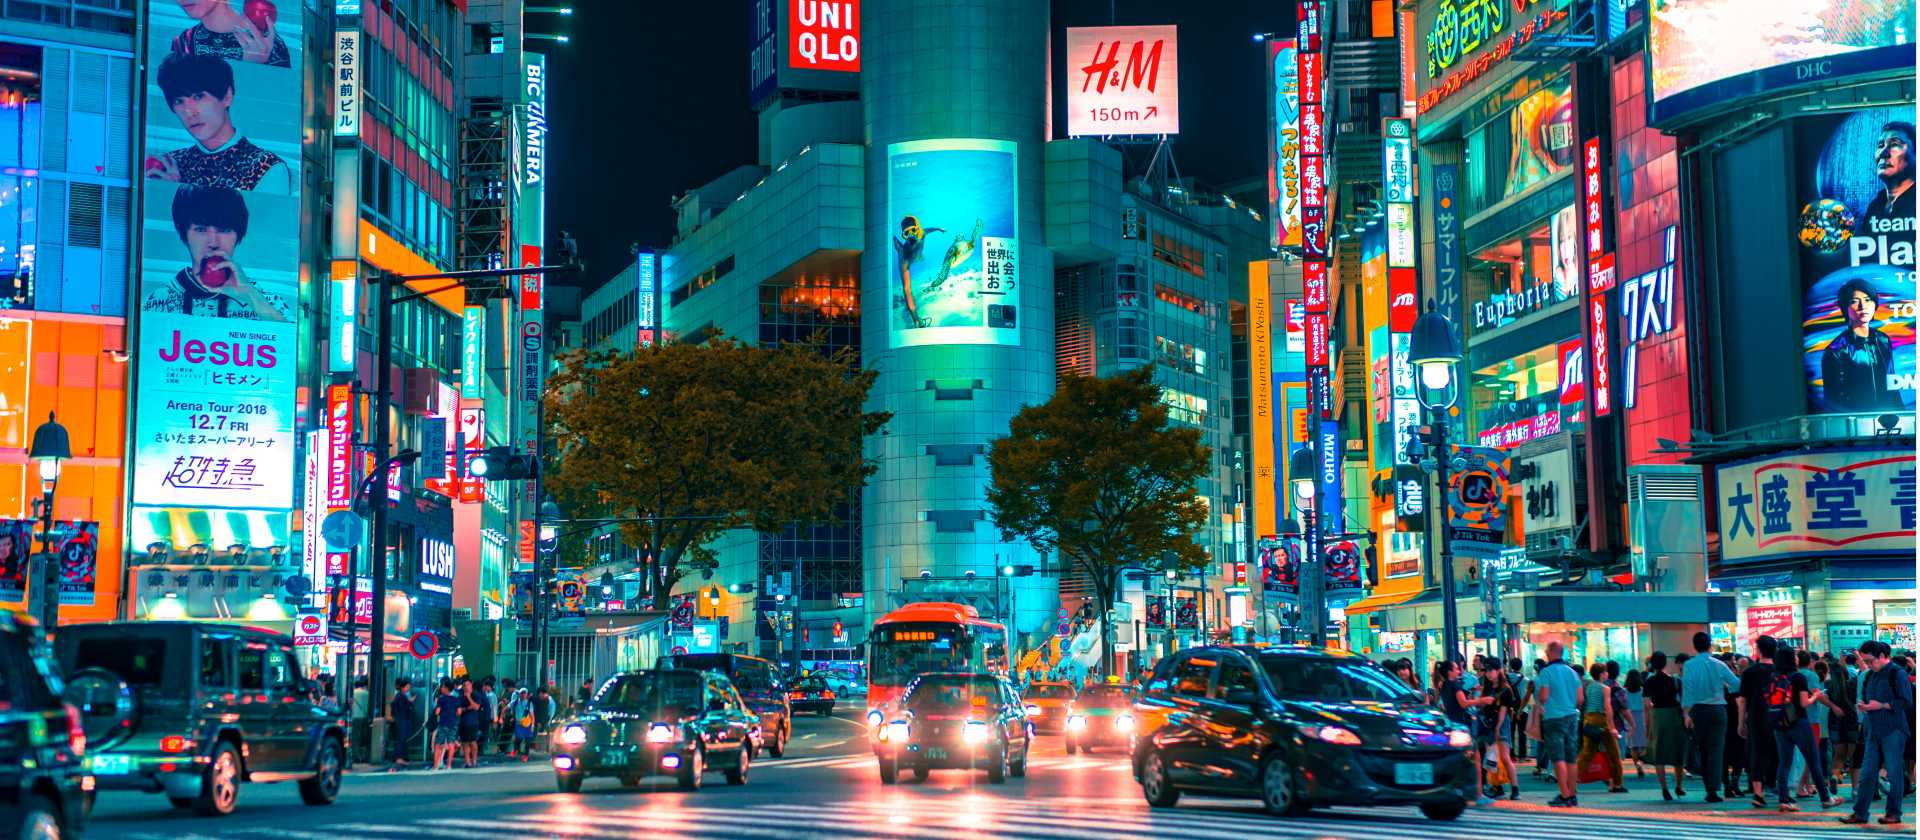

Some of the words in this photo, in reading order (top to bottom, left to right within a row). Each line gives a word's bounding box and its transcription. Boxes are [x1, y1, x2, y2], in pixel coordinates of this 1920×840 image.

[799, 1, 852, 30] UNI
[751, 33, 776, 91] PRIME
[799, 32, 858, 64] QLO
[339, 36, 354, 127] 渋谷駅前ビル
[527, 64, 540, 96] BIC
[1081, 39, 1164, 94] H&M
[1797, 61, 1832, 79] DHC
[987, 249, 1015, 260] 世界に
[1393, 292, 1415, 307] JTB
[1476, 275, 1550, 329] Euphoria
[1620, 225, 1677, 408] クスリ
[159, 330, 277, 368] Jesus
[229, 331, 247, 339] NEW
[249, 333, 277, 342] SINGLE
[166, 400, 203, 411] Arena
[208, 401, 234, 413] Tour
[237, 404, 267, 415] 2018
[189, 414, 227, 430] 12.7
[230, 421, 249, 431] FRI
[155, 433, 276, 448] さいたまスーパーアリーナ
[1506, 424, 1529, 443] 海外旅行
[331, 420, 347, 499] サンドラッグ
[1323, 433, 1335, 484] MIZUHO
[1402, 480, 1423, 515] HUB
[423, 538, 454, 579] LUSH
